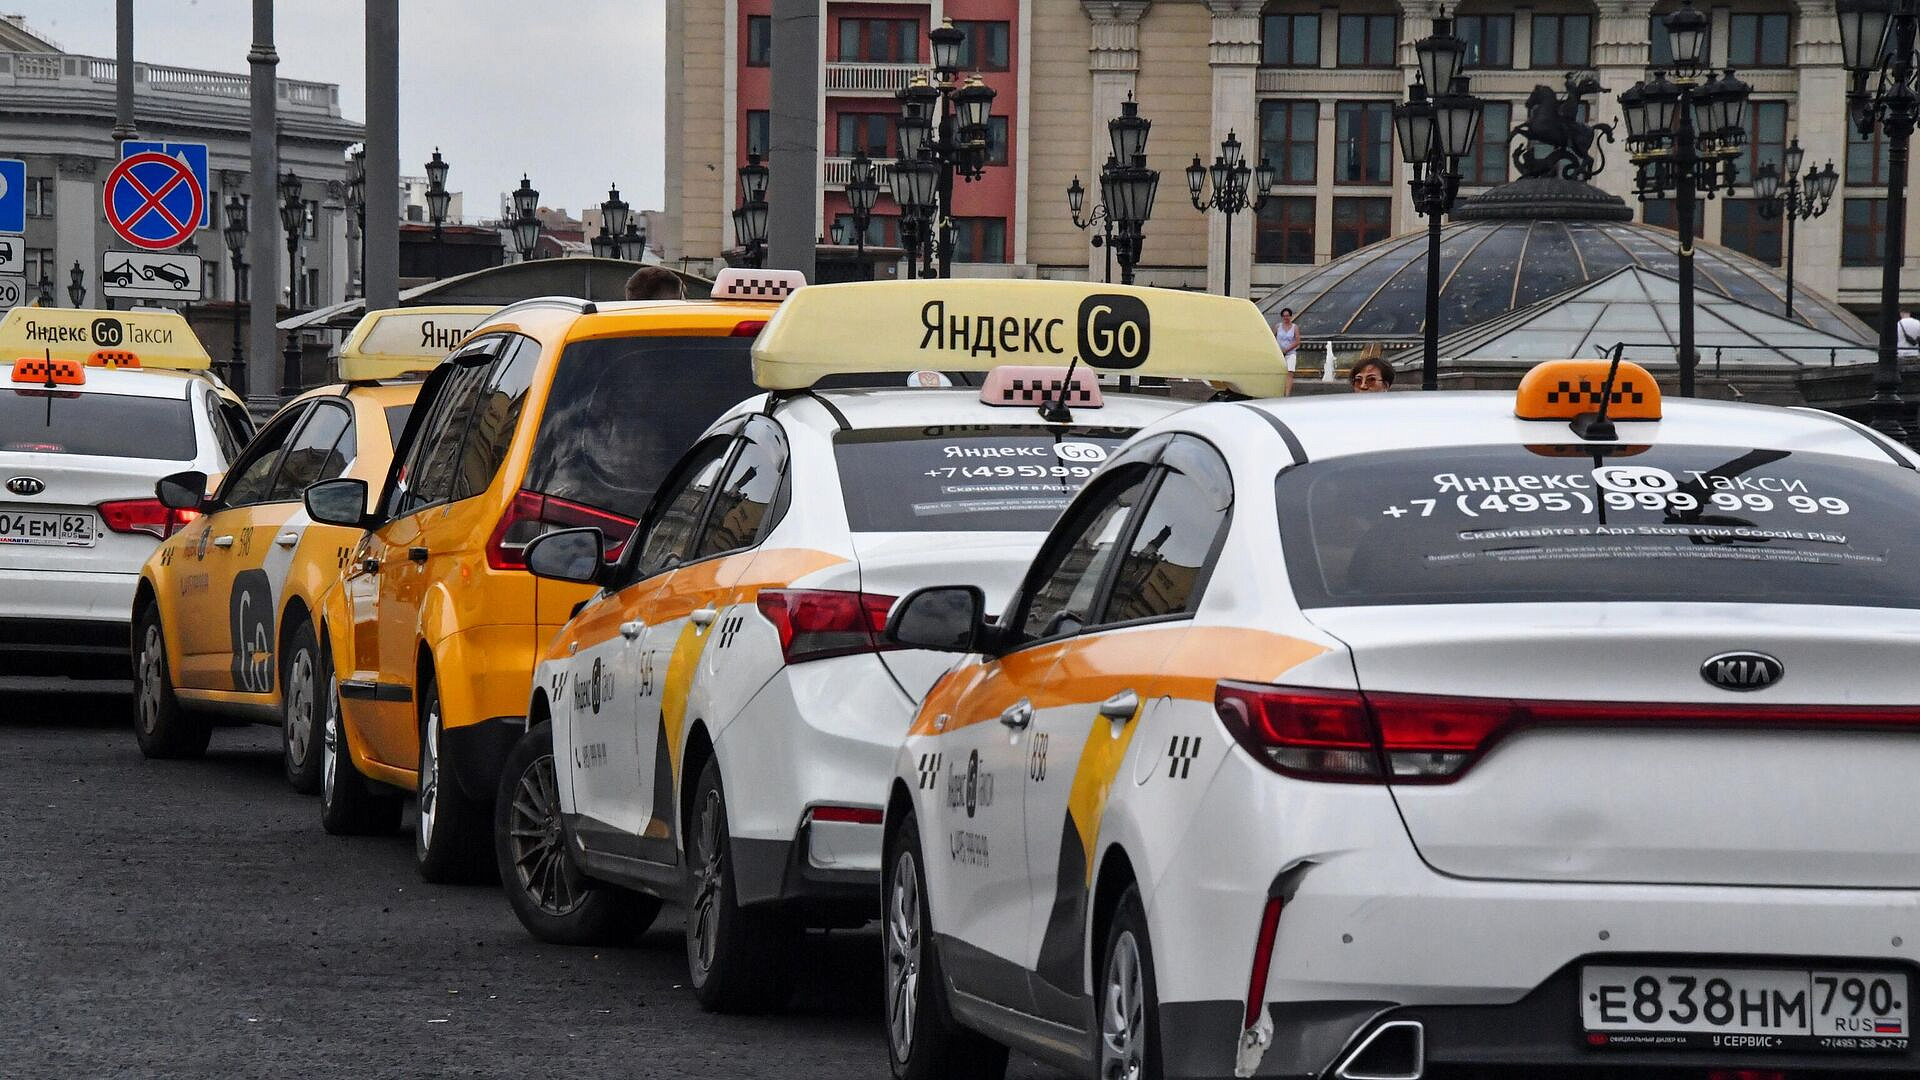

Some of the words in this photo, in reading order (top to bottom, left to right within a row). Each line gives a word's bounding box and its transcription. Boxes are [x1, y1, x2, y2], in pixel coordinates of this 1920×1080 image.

[26, 321, 86, 342] Яндекс
[94, 319, 119, 343] Go
[126, 323, 173, 344] Такси
[920, 300, 1064, 357] Яндекс
[1086, 305, 1143, 358] Go
[943, 445, 1048, 458] Яндекс
[1061, 444, 1099, 459] Go
[12, 479, 40, 492] KIA
[1433, 473, 1591, 493] Яндекс
[1604, 469, 1667, 488] Go
[1683, 470, 1809, 493] Такси
[1382, 499, 1437, 518] +7
[1456, 491, 1594, 517] (495)
[1603, 491, 1698, 511] 999
[1710, 492, 1774, 512] 99
[1787, 495, 1850, 515] 99
[61, 531, 78, 539] RUS
[63, 516, 85, 533] 62
[1459, 527, 1575, 541] Скачивайте
[1579, 527, 1590, 535] в
[1595, 525, 1635, 536] App
[1638, 525, 1690, 536] Store
[1694, 527, 1731, 537] или
[1735, 527, 1804, 539] Google
[1807, 531, 1846, 544] Play
[1716, 660, 1771, 683] KIA
[1600, 975, 1807, 1028] Е838НМ
[1814, 976, 1893, 1017] 790
[1835, 1017, 1873, 1032] RUS
[1724, 1036, 1772, 1047] СЕРВИС
